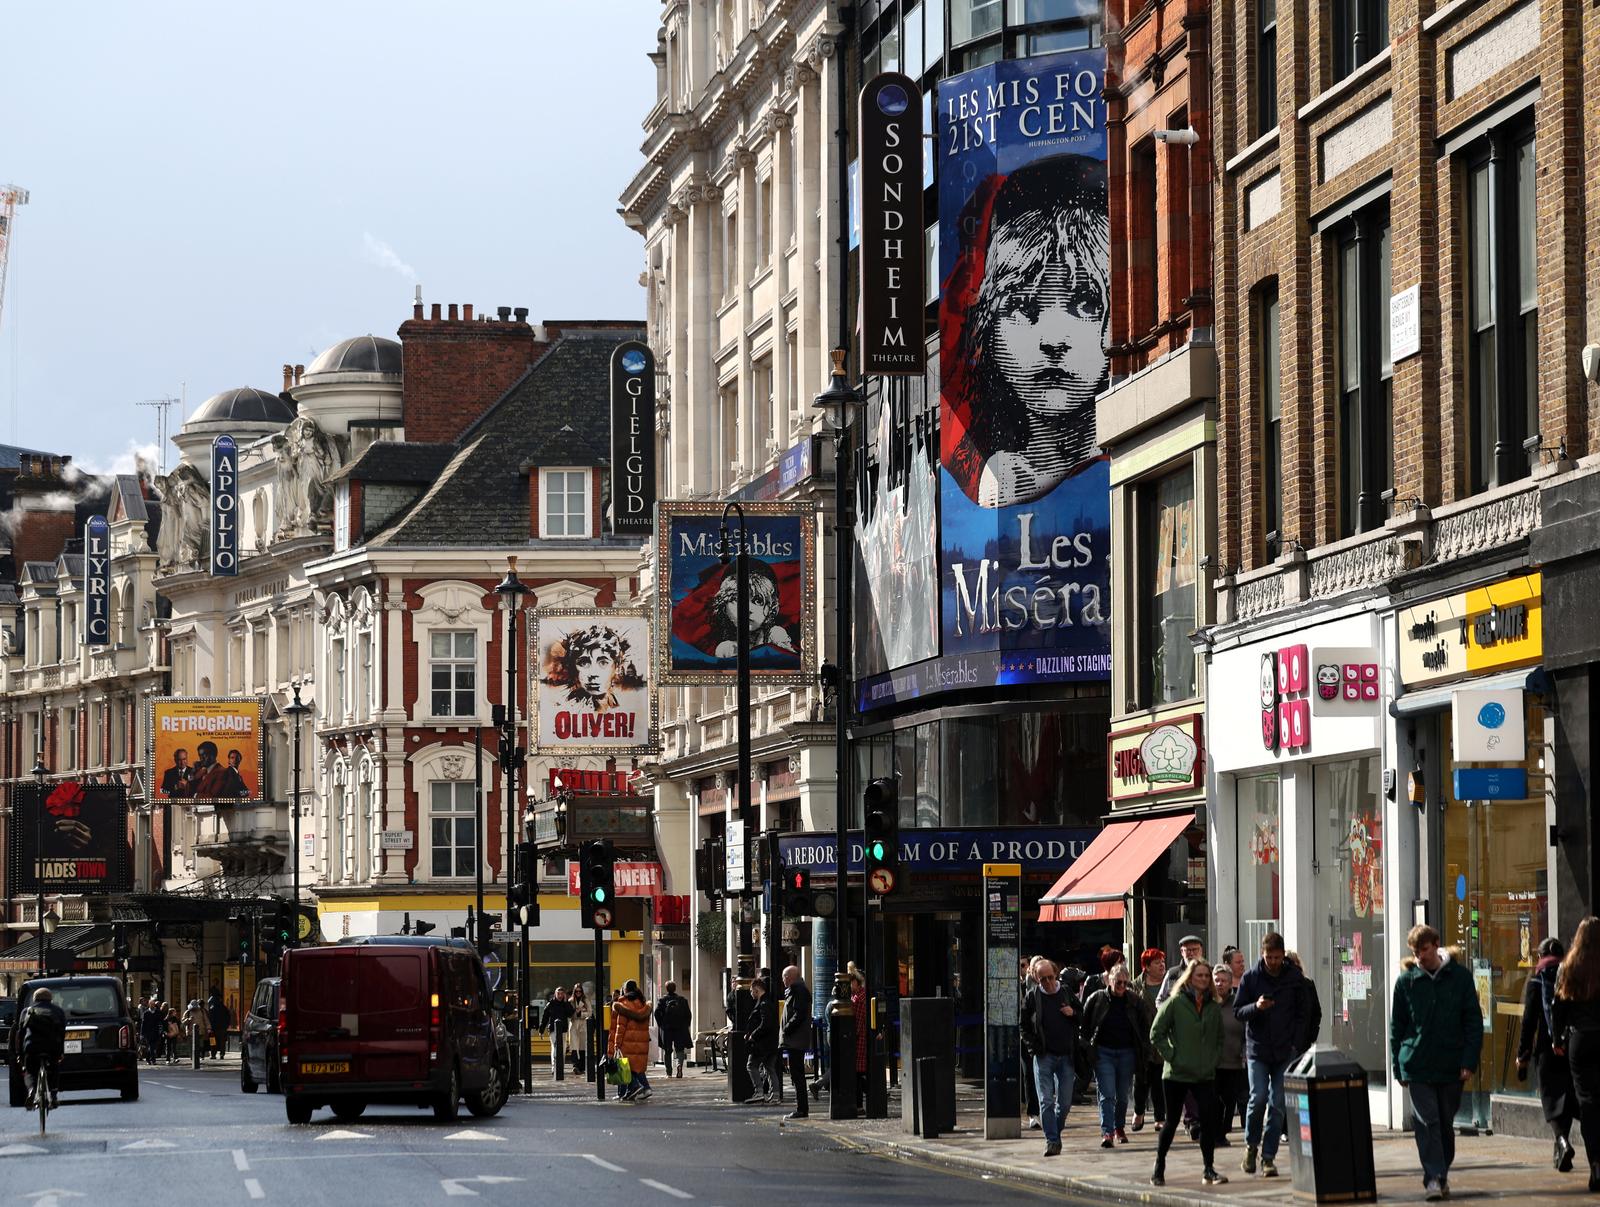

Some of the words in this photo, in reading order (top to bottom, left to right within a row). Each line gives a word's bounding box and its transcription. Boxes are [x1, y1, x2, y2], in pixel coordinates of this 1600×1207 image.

[948, 89, 979, 124] LES
[986, 77, 1040, 111] MIS
[1055, 70, 1098, 100] FO
[949, 111, 1001, 156] 21ST
[1018, 99, 1097, 137] CEN
[1028, 137, 1069, 148] HUFFINGTON
[1070, 135, 1086, 143] POST
[882, 123, 907, 347] SONDHEIM
[872, 354, 916, 363] THEATRE
[625, 377, 644, 513] GIELGUD
[216, 456, 235, 569] APOLLO
[1017, 513, 1092, 571] Les
[89, 537, 108, 636] LYRIC
[952, 557, 1111, 638] Miséra
[1036, 655, 1075, 674] DAZZLING
[1077, 655, 1112, 672] STAGING
[161, 715, 252, 732] RETROGRADE
[555, 711, 636, 739] OLIVER!
[35, 862, 107, 879] HADESTOWN
[795, 845, 837, 865] REBOR
[929, 842, 959, 861] OF
[967, 841, 983, 860] A
[991, 840, 1086, 860] PRODU
[87, 960, 109, 970] HADES
